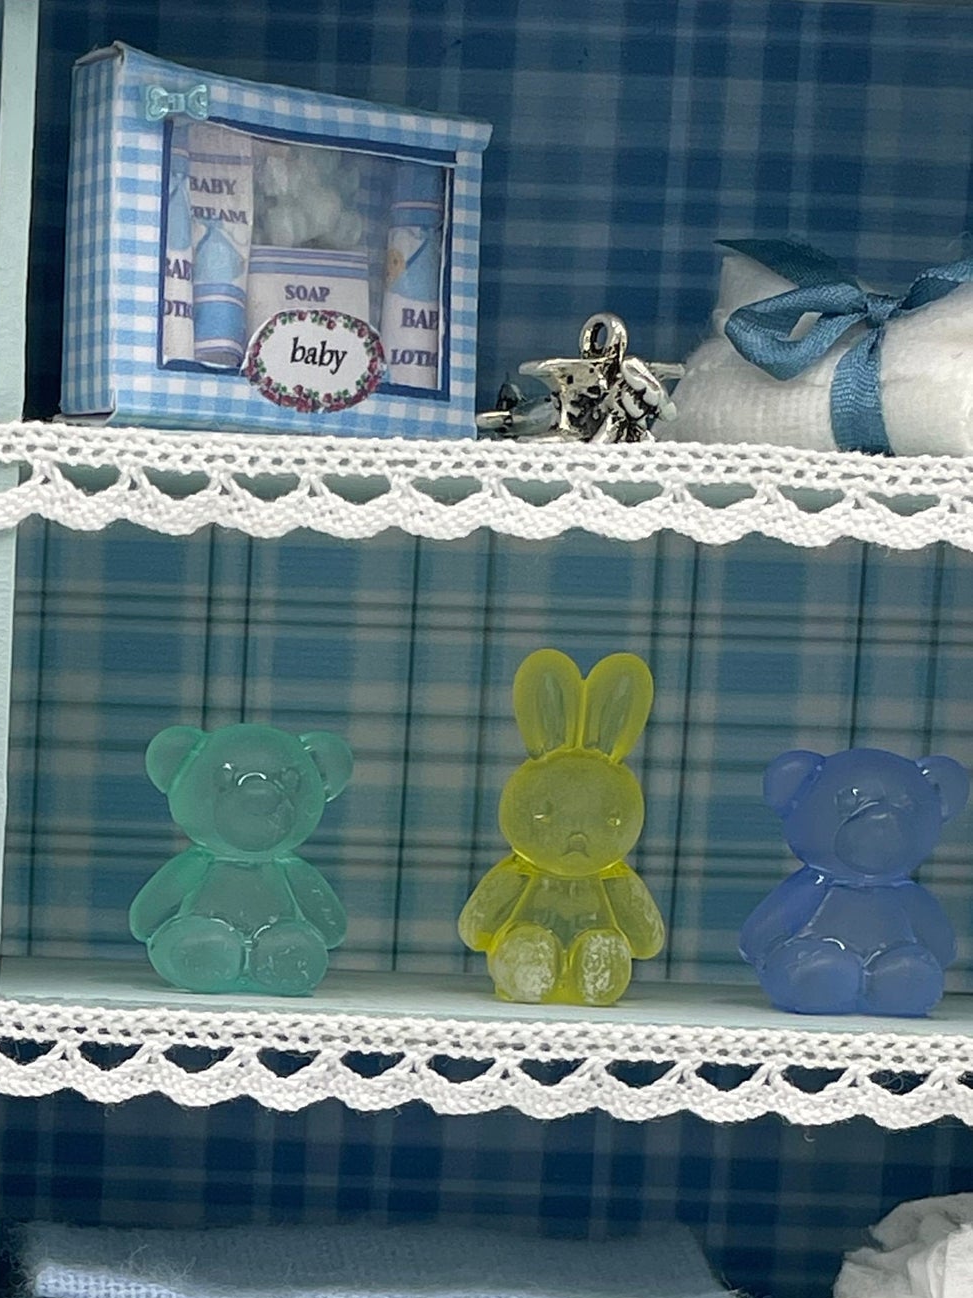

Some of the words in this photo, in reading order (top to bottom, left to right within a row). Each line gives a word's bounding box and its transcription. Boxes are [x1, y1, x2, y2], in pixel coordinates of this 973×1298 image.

[189, 175, 237, 196] BABY
[190, 206, 248, 225] REAM
[284, 284, 331, 302] SOAP
[290, 337, 347, 375] baby
